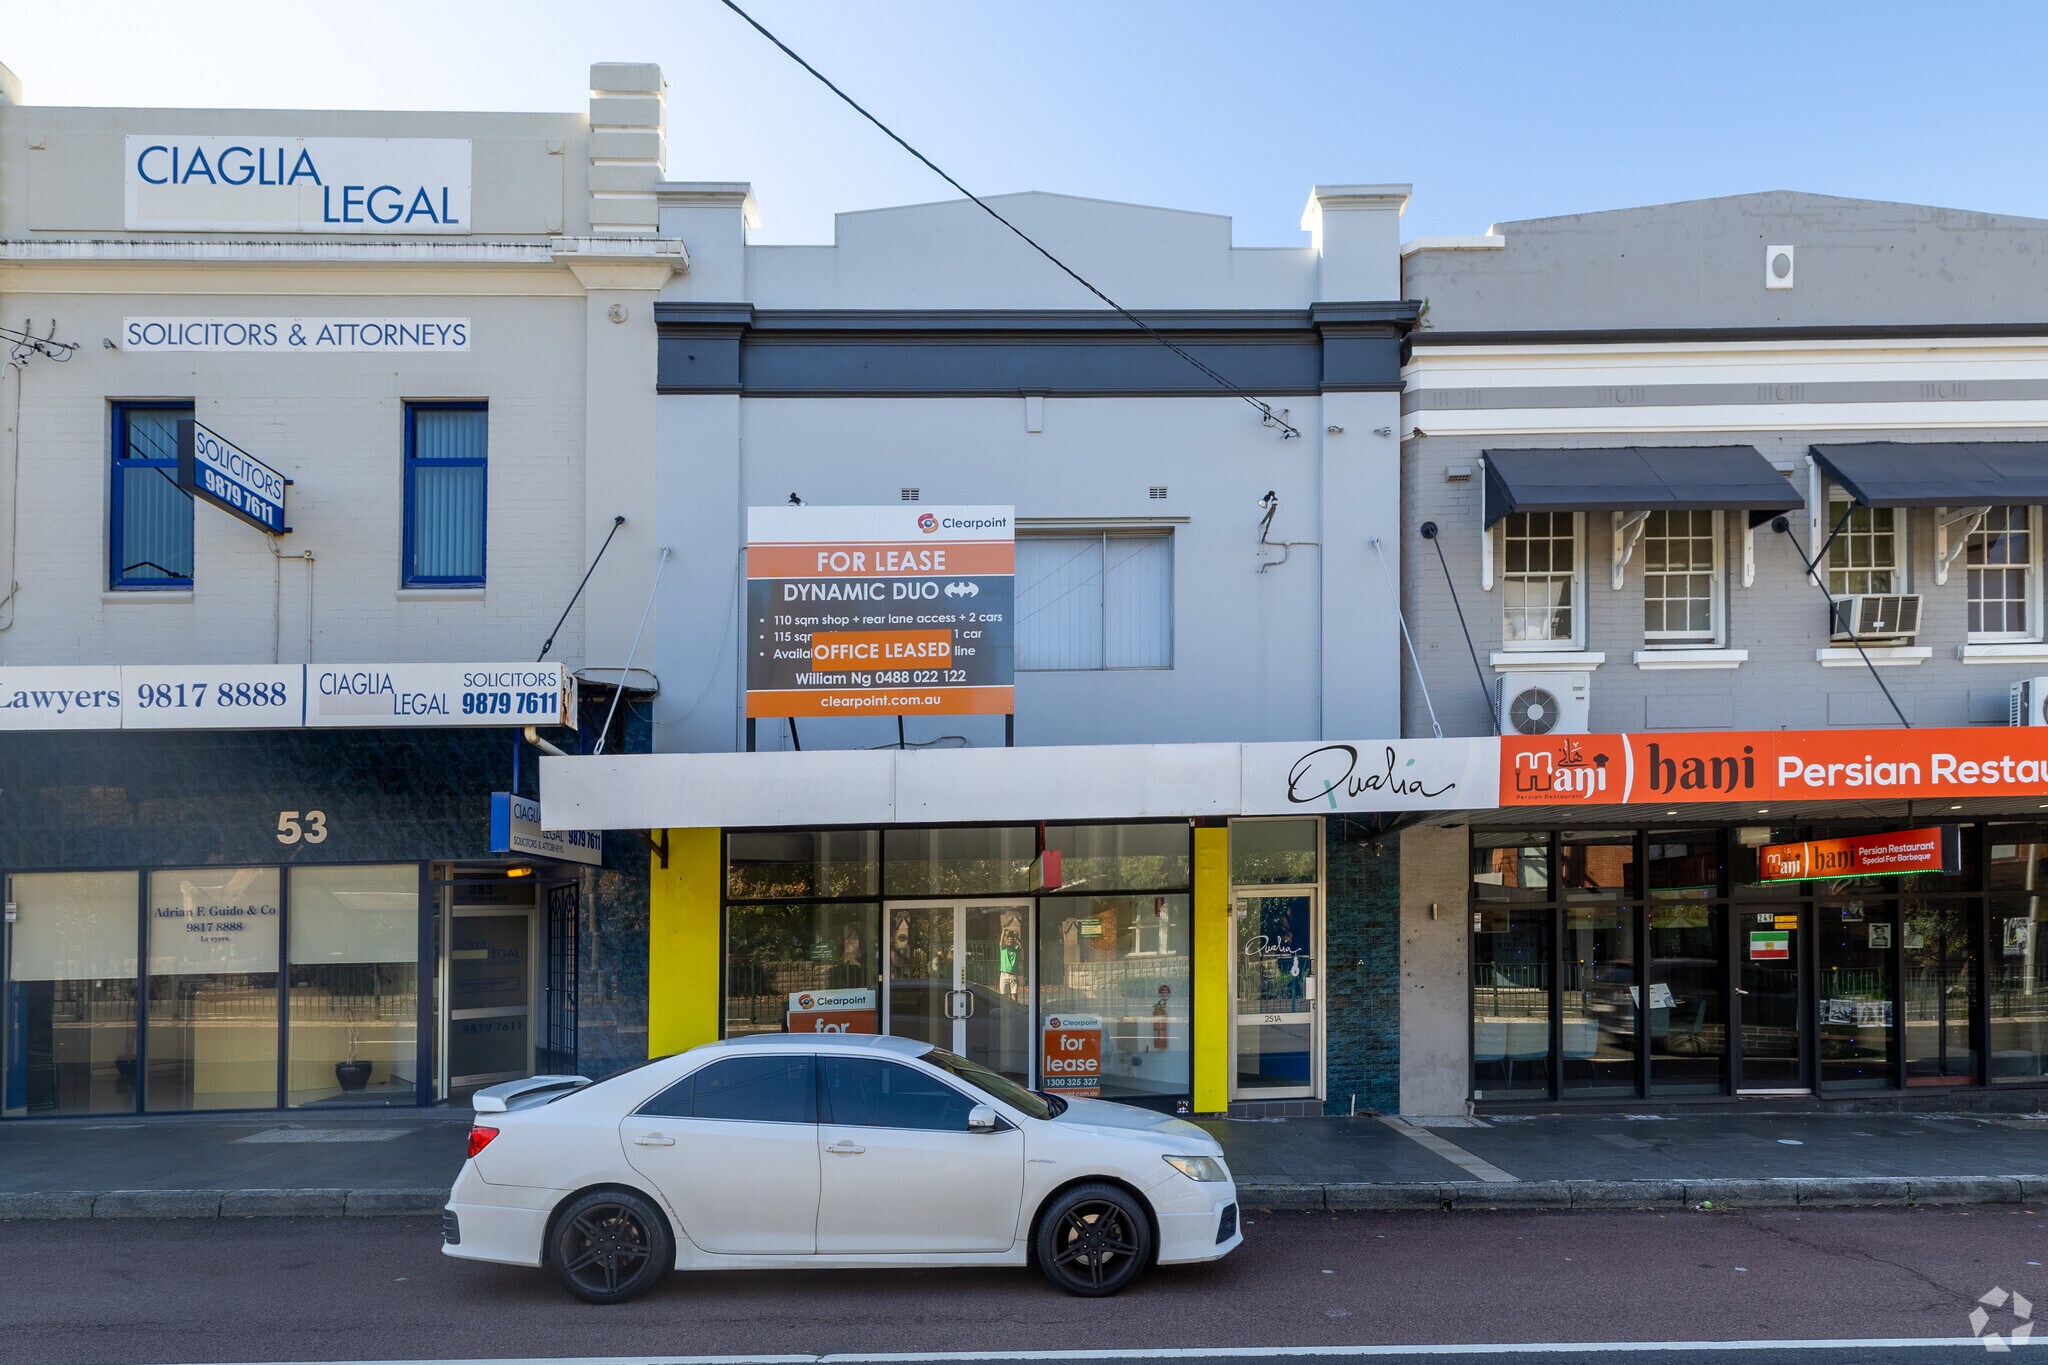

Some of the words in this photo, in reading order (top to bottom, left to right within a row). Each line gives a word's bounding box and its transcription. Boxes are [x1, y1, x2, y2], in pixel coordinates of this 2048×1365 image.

[137, 145, 322, 185] CIAGLIA
[324, 185, 458, 224] LEGAL
[128, 322, 278, 346] SOLICITORS
[288, 323, 306, 346] &
[315, 322, 467, 346] ATTORNEYS
[196, 432, 281, 500] SOLICITORS
[205, 469, 242, 507] 9879
[243, 491, 273, 525] 7611
[942, 517, 1007, 530] Clearpoint
[817, 552, 866, 572] FOR
[875, 550, 946, 571] LEASE
[783, 582, 885, 602] DYNAMIC
[893, 581, 940, 601] DUO
[774, 615, 792, 626] 110
[794, 617, 819, 627] sqm
[822, 614, 850, 627] shop
[862, 615, 886, 625] rear
[888, 614, 914, 624] lane
[917, 614, 956, 623] access
[968, 612, 976, 622] 2
[979, 613, 1003, 622] cars
[774, 632, 792, 642] 115
[954, 629, 959, 639] 1
[963, 630, 983, 639] car
[773, 648, 813, 660] Availa
[954, 646, 976, 656] line
[814, 644, 879, 660] OFFICE
[885, 642, 951, 658] LEASED
[319, 672, 395, 695] CIAGLIA
[463, 672, 557, 688] SOLICITORS
[795, 672, 847, 685] William
[851, 672, 872, 687] Ng
[875, 671, 910, 684] 0488
[913, 671, 939, 683] 022
[943, 670, 967, 682] 122
[138, 683, 208, 708] 9817
[217, 682, 287, 707] 8888
[462, 692, 512, 715] 9879
[516, 692, 558, 714] 7611
[820, 695, 941, 709] clearpoint.com.au
[394, 693, 450, 715] LEGAL
[1287, 745, 1456, 809] Qualia
[1646, 743, 1755, 795] hani
[1778, 755, 1921, 787] Persian
[276, 810, 328, 845] 53
[513, 836, 537, 850] SOLICITORS
[541, 842, 564, 854] ATTORNEYS
[568, 830, 586, 848] 9879
[587, 830, 601, 851] 7611
[1858, 846, 1888, 856] Persian
[1888, 841, 1935, 854] Restaurant
[1814, 844, 1856, 872] hani
[1862, 855, 1885, 866] Special
[1885, 854, 1897, 863] For
[1897, 853, 1931, 863] Barbeque
[468, 884, 493, 895] 253
[154, 907, 193, 918] Adrian
[197, 906, 206, 917] F.
[209, 905, 244, 917] Guido
[246, 905, 257, 916] &
[260, 904, 276, 916] Co
[1758, 914, 1773, 922] 249
[186, 923, 213, 933] 9817
[216, 922, 243, 932] 8888
[1245, 935, 1302, 957] Qualia
[817, 996, 866, 1006] Clearpoint
[463, 1023, 492, 1034] 9879
[496, 1021, 522, 1032] 7611
[815, 1018, 850, 1034] for
[1063, 1019, 1098, 1027] Clearpoint
[1264, 1015, 1282, 1023] 251A
[1060, 1034, 1086, 1051] for
[1046, 1056, 1098, 1072] lease
[1047, 1079, 1065, 1087] 1300
[1084, 1078, 1098, 1086] 327
